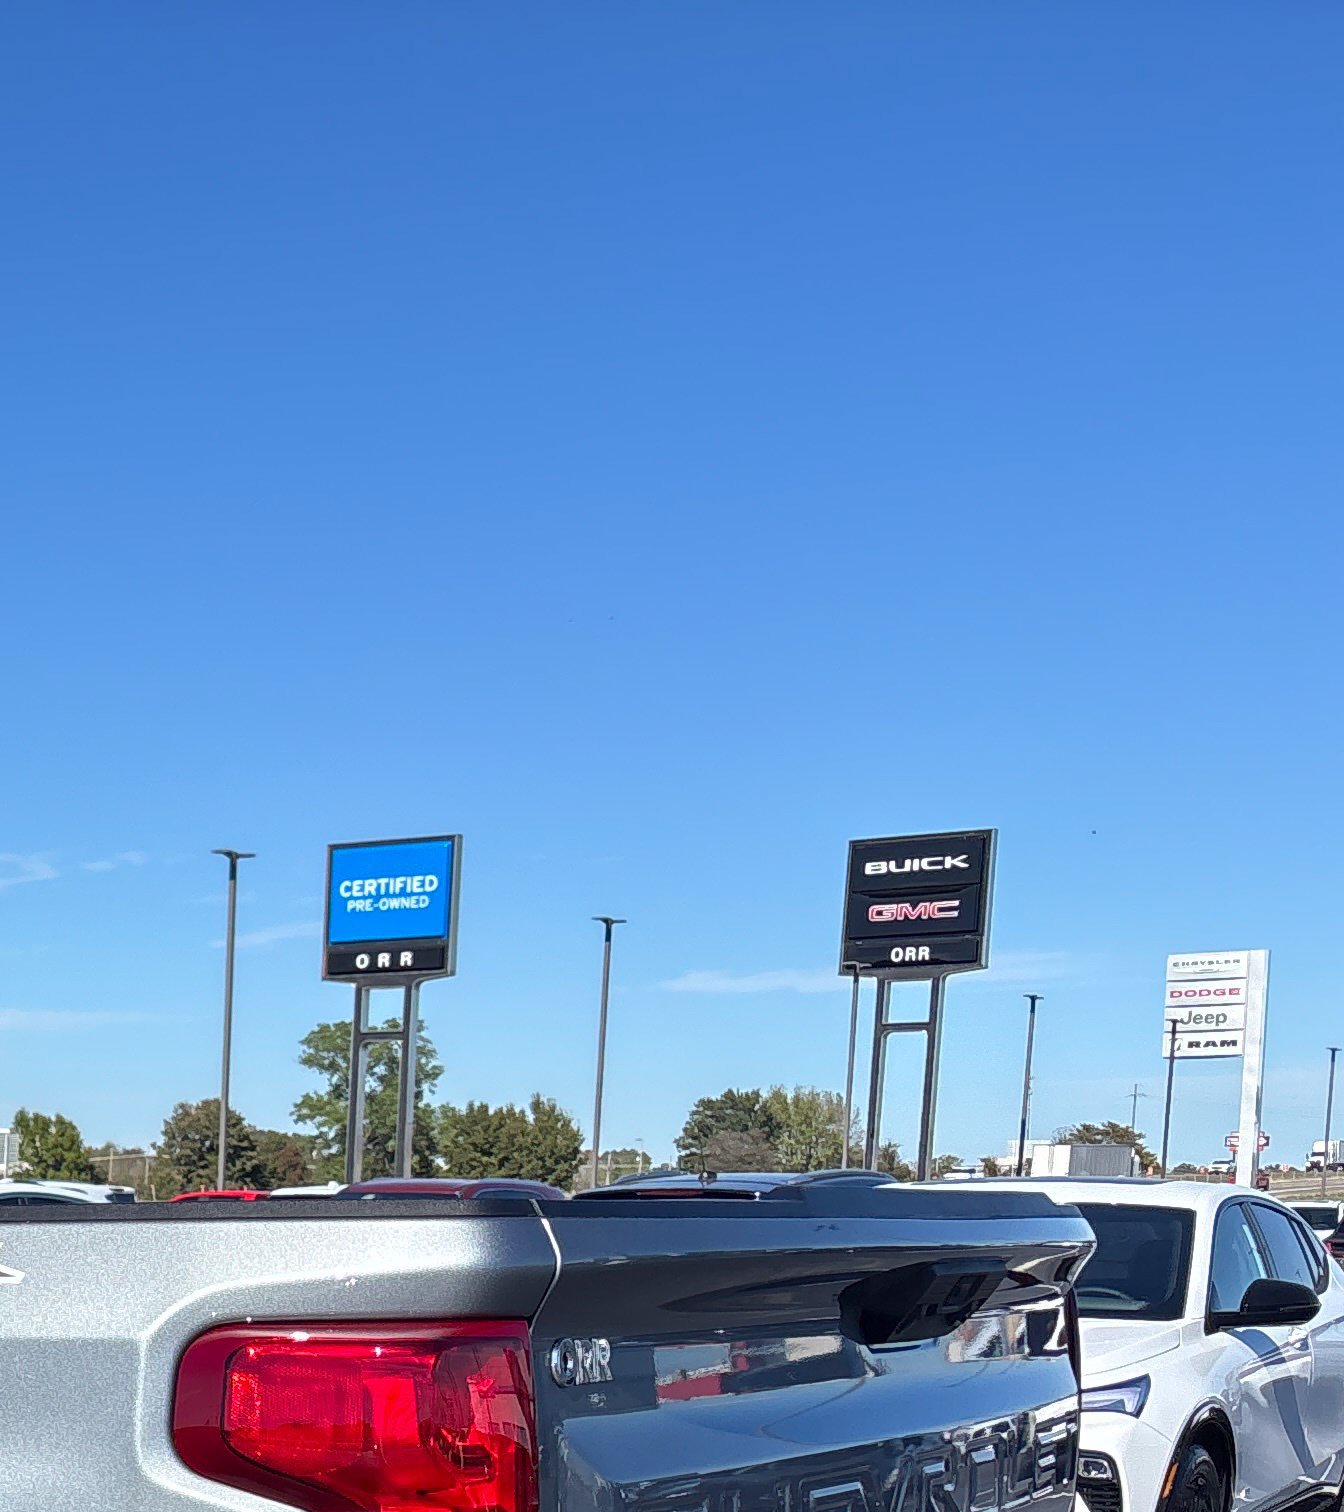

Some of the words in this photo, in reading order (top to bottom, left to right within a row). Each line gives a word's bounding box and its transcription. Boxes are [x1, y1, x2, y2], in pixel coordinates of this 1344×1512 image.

[865, 855, 969, 874] BUICK
[339, 874, 439, 898] CERTIFIED
[346, 895, 430, 912] PRE-OWNED
[868, 900, 961, 922] GMC
[891, 946, 930, 962] ORR
[1172, 959, 1240, 968] CHRYSLER
[1170, 988, 1241, 998] DODGE
[1179, 1010, 1227, 1026] Jeep
[1187, 1040, 1238, 1048] RAM
[551, 1338, 613, 1387] ORR
